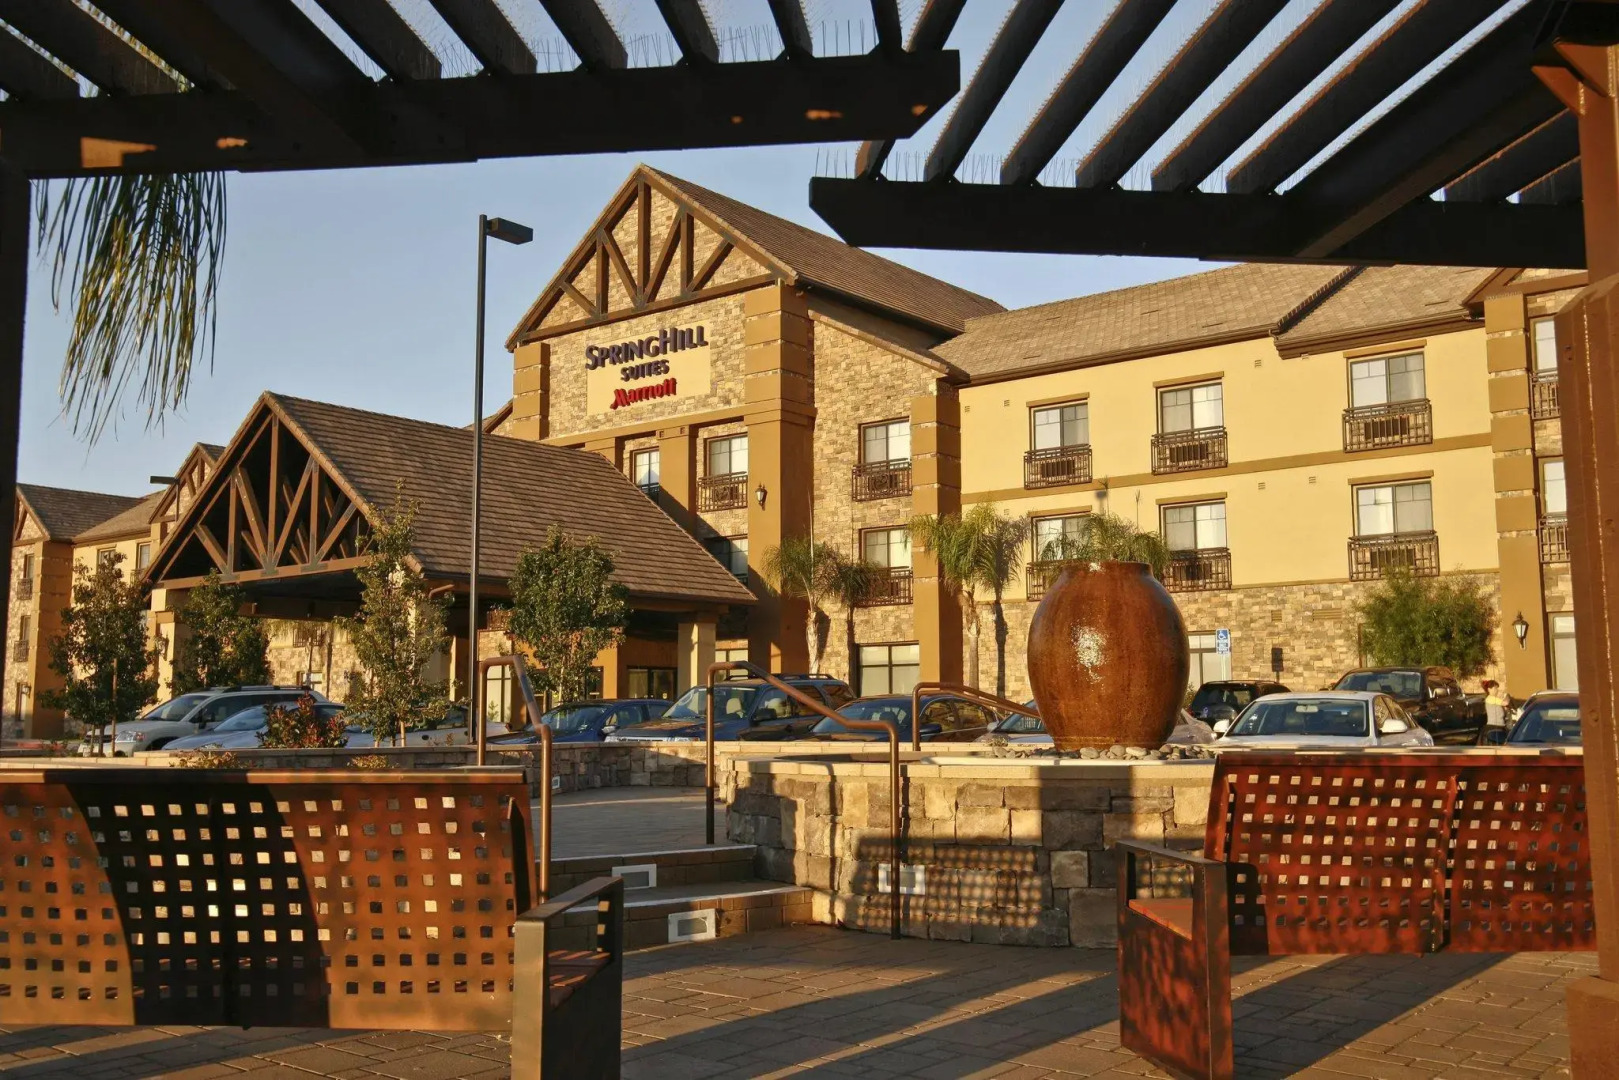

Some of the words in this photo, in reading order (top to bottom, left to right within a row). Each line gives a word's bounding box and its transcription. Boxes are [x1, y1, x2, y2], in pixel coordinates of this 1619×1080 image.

[585, 325, 709, 370] SPRINGHILL
[620, 359, 670, 382] SUITES
[610, 377, 677, 410] Marriott
